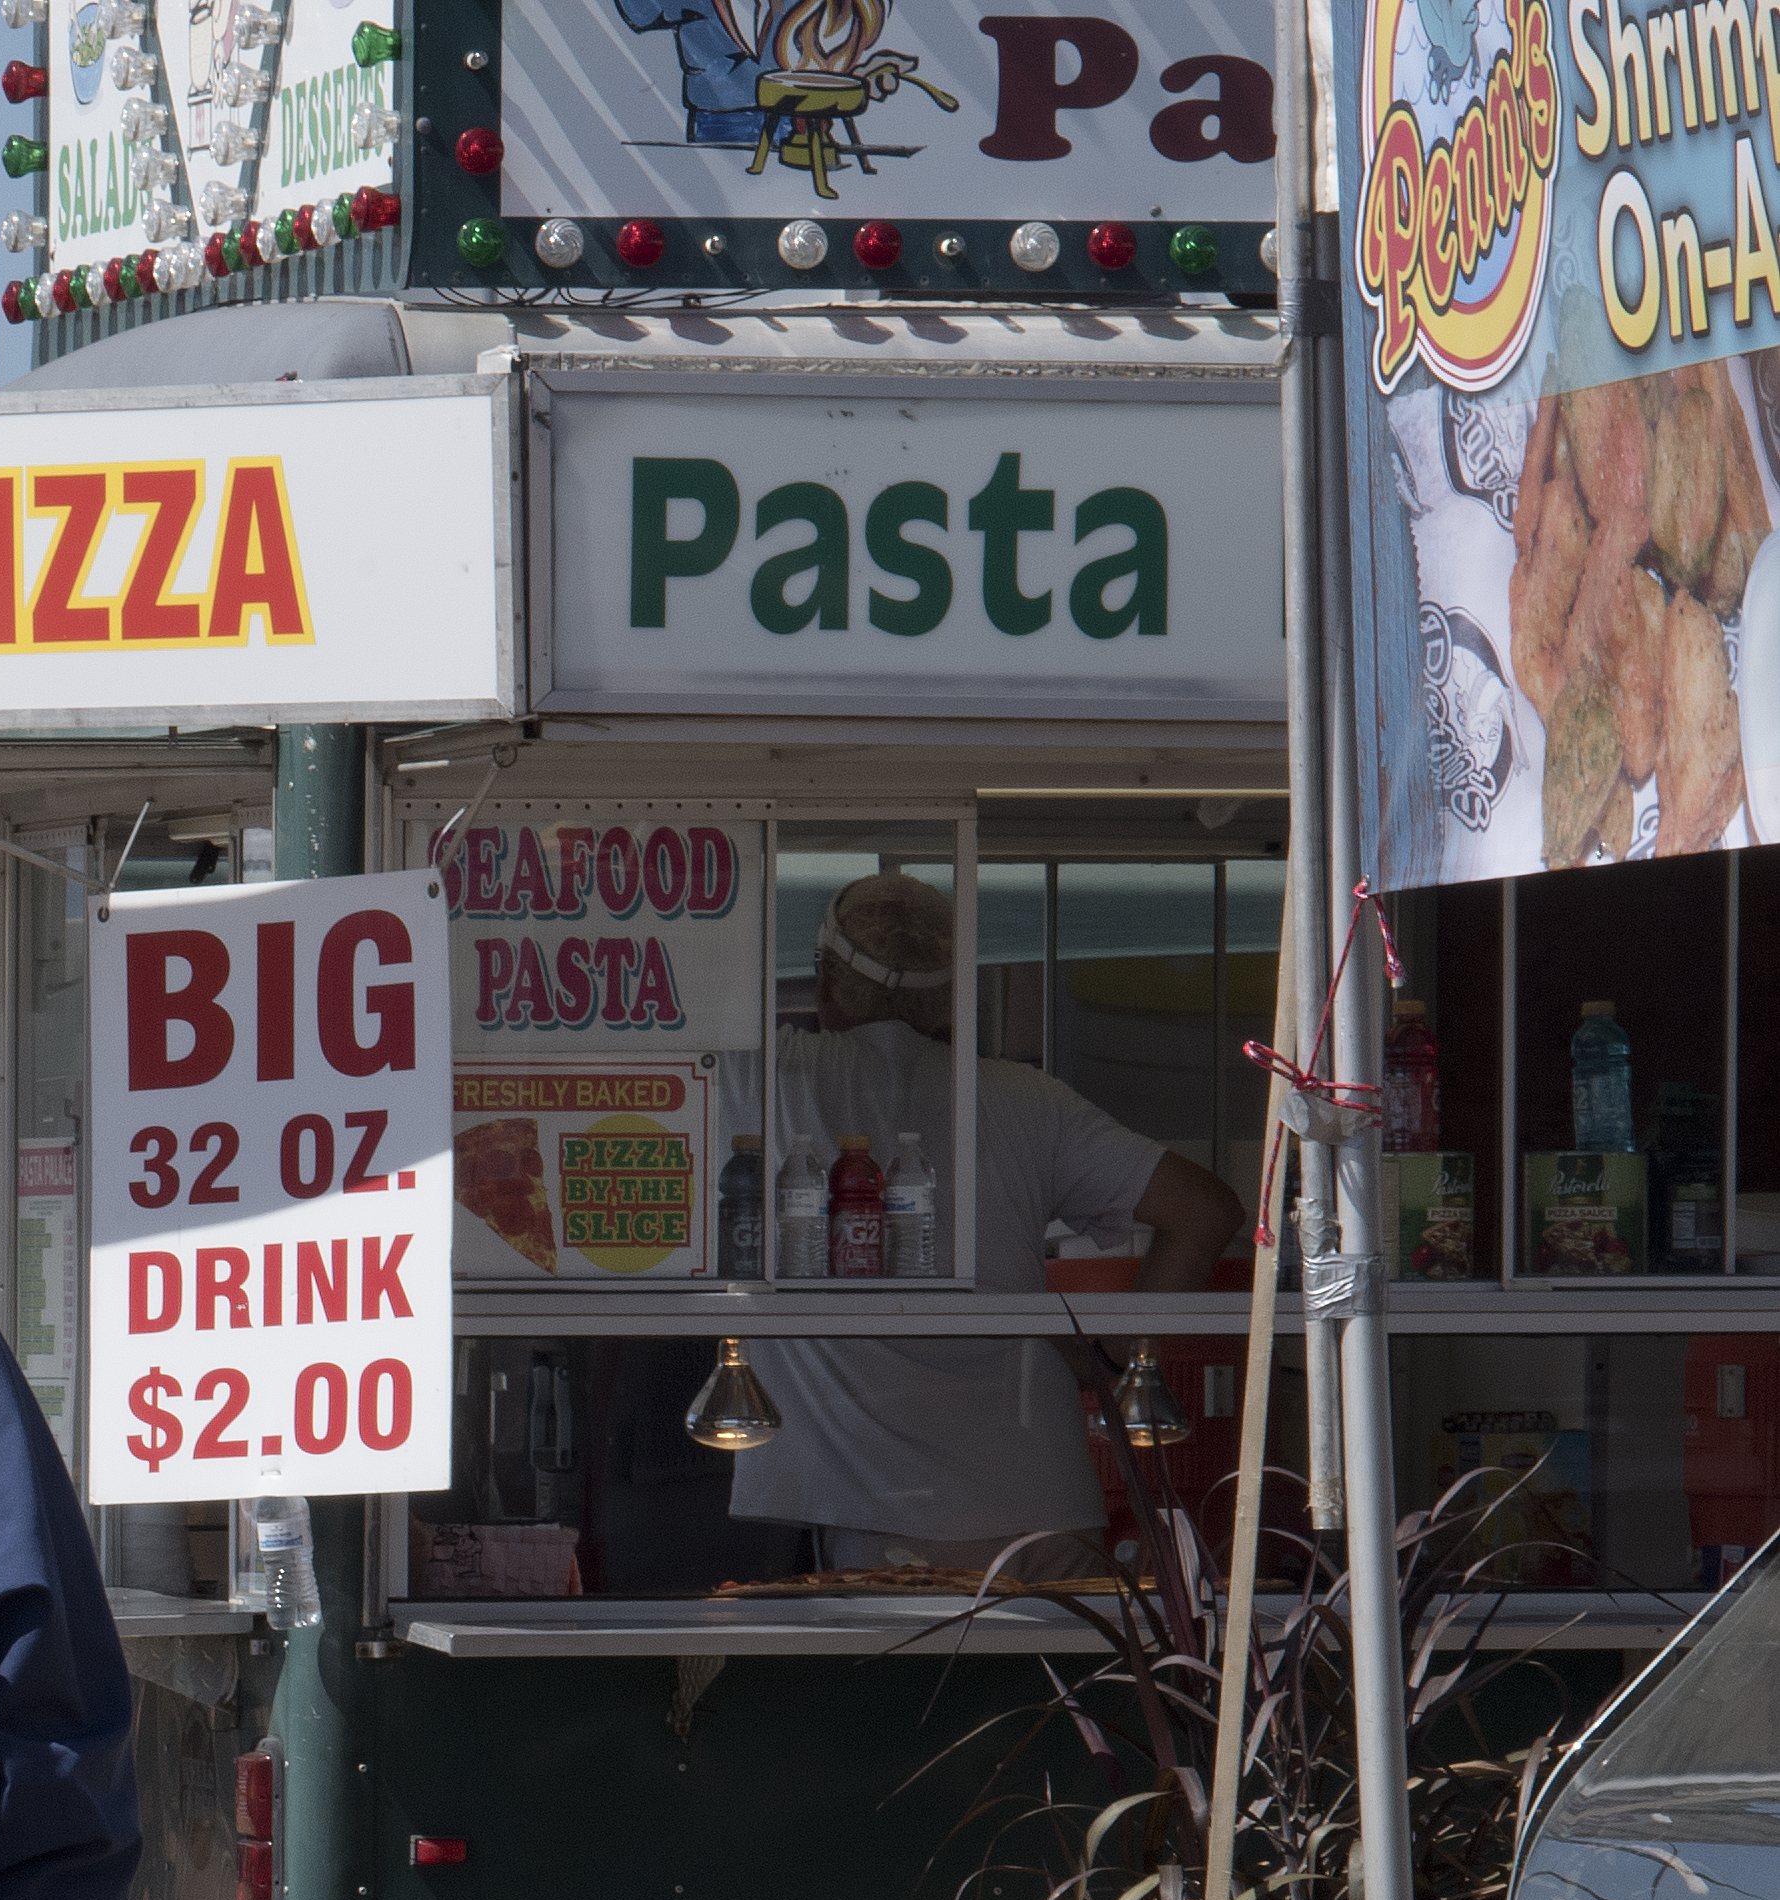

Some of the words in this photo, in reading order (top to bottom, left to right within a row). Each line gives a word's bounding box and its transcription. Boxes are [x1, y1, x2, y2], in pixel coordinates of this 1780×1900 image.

[58, 130, 154, 242] SALAD
[630, 452, 1168, 640] Pasta
[426, 826, 739, 921] SEAFOOD
[125, 908, 416, 1092] BIG
[474, 936, 687, 1032] PASTA
[453, 1080, 573, 1107] FRESHLY
[575, 1080, 672, 1107] BAKED
[128, 1120, 240, 1209] 32
[279, 1109, 417, 1200] OZ.
[562, 1138, 688, 1169] PIZZA
[565, 1177, 612, 1204] BY
[615, 1176, 686, 1204] THE
[566, 1210, 687, 1244] SLICE
[846, 1219, 880, 1245] G2
[127, 1232, 415, 1336] DRINK
[126, 1356, 414, 1474] $2.00
